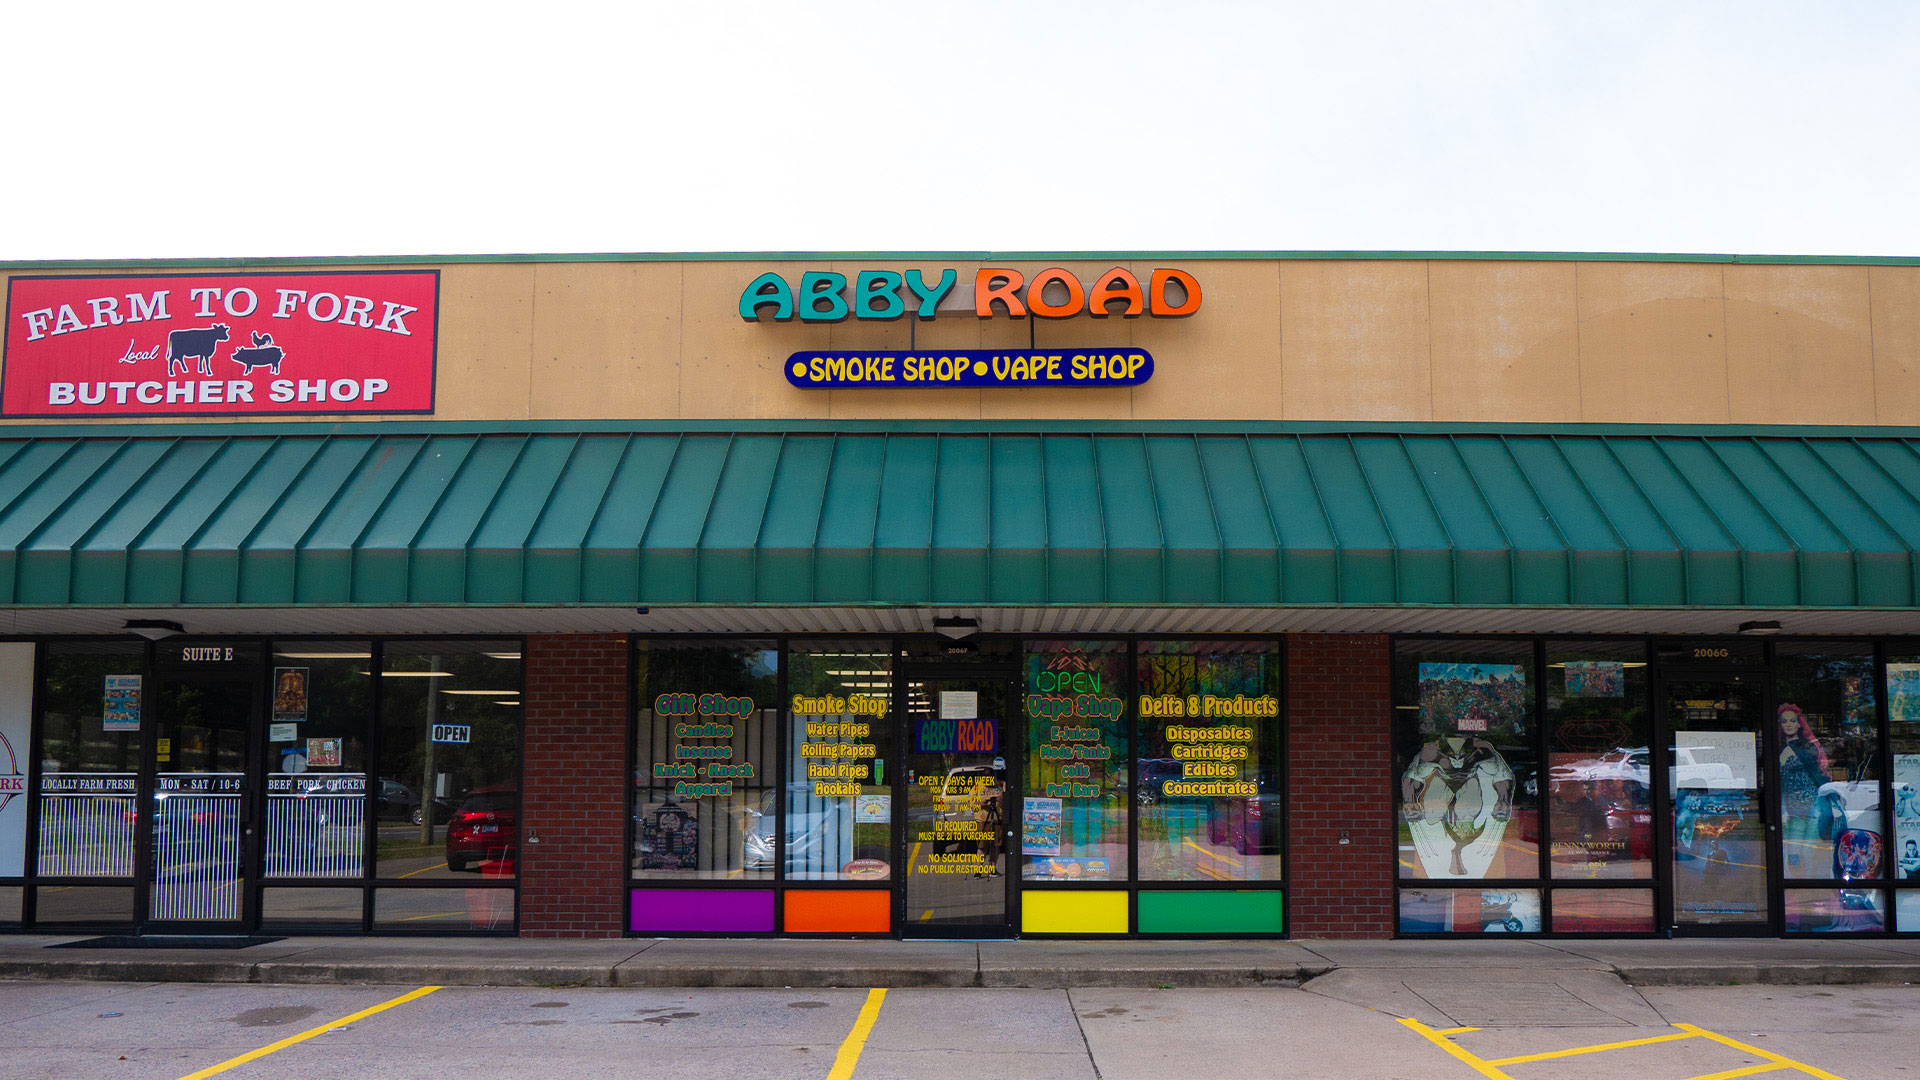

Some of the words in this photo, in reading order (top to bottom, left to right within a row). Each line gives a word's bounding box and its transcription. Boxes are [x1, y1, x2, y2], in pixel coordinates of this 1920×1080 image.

[738, 269, 957, 323] ABBY
[974, 266, 1203, 321] ROAD
[22, 290, 171, 341] FARM
[190, 287, 258, 318] TO
[272, 288, 418, 336] FORK
[118, 339, 160, 364] Local
[809, 357, 895, 381] SMOKE
[903, 357, 969, 381] SHOP
[992, 355, 1062, 380] VAPE
[1070, 354, 1145, 379] SHOP
[49, 380, 254, 405] BUTCHER
[269, 378, 390, 403] SHOP
[182, 647, 221, 661] SUITE
[224, 648, 233, 661] E
[1694, 649, 1728, 657] 2006G
[1036, 671, 1101, 693] OPEN
[655, 693, 696, 717] Gift
[698, 693, 754, 719] Shop
[792, 694, 846, 717] Smoke
[847, 694, 888, 719] Shop
[1028, 695, 1073, 721] Vape
[1075, 694, 1123, 721] Shop
[1140, 694, 1184, 717] Delta
[1187, 695, 1200, 717] 8
[1203, 694, 1279, 717] Products
[434, 725, 468, 741] OPEN
[675, 723, 733, 738] Candles
[806, 722, 839, 738] Water
[840, 722, 869, 738] Pipes
[1458, 719, 1487, 731] MARVEL
[921, 720, 956, 751] ABBY
[957, 720, 994, 751] ROAD
[1051, 727, 1100, 741] E-Juices
[1166, 726, 1253, 744] Disposables
[675, 744, 732, 759] Insense
[801, 743, 838, 760] Rolling
[840, 743, 876, 760] Papers
[1040, 744, 1110, 760] Mods/Tanks
[1172, 743, 1248, 761] Cartridges
[654, 763, 696, 778] Knick
[708, 763, 754, 778] Knack
[808, 763, 837, 779] Hand
[838, 763, 868, 780] Pipes
[1061, 763, 1090, 778] coils
[1183, 762, 1237, 777] Edibles
[42, 779, 77, 790] LOCALLY
[80, 779, 103, 790] FARM
[105, 779, 135, 790] FRESH
[160, 779, 179, 790] MON
[191, 779, 208, 790] SAT
[220, 779, 241, 790] 10-6
[268, 779, 292, 790] BEEF
[297, 779, 321, 790] PORK
[326, 779, 366, 790] CHICKEN
[815, 780, 861, 797] Hookahs
[918, 775, 938, 785] OPEN
[940, 776, 945, 785] 7
[946, 775, 966, 786] DAYS
[967, 776, 973, 785] A
[974, 775, 995, 786] WEEK
[1162, 780, 1258, 797] Concentrates
[675, 781, 732, 798] Apparel
[1047, 783, 1072, 797] Puff
[1073, 783, 1100, 798] Bars
[935, 821, 942, 831] ID
[944, 821, 978, 831] REQUIRED
[918, 832, 935, 840] MUST
[936, 832, 945, 840] BE
[946, 832, 953, 840] 21
[953, 832, 962, 840] TO
[963, 832, 995, 840] PURCHASE
[1552, 841, 1625, 850] PENNYWORTH
[928, 853, 940, 863] NO
[941, 853, 985, 863] SOLICITING
[1588, 860, 1607, 869] epix
[918, 865, 929, 874] NO
[930, 865, 954, 874] PUBLIC
[956, 865, 996, 874] RESTROOM
